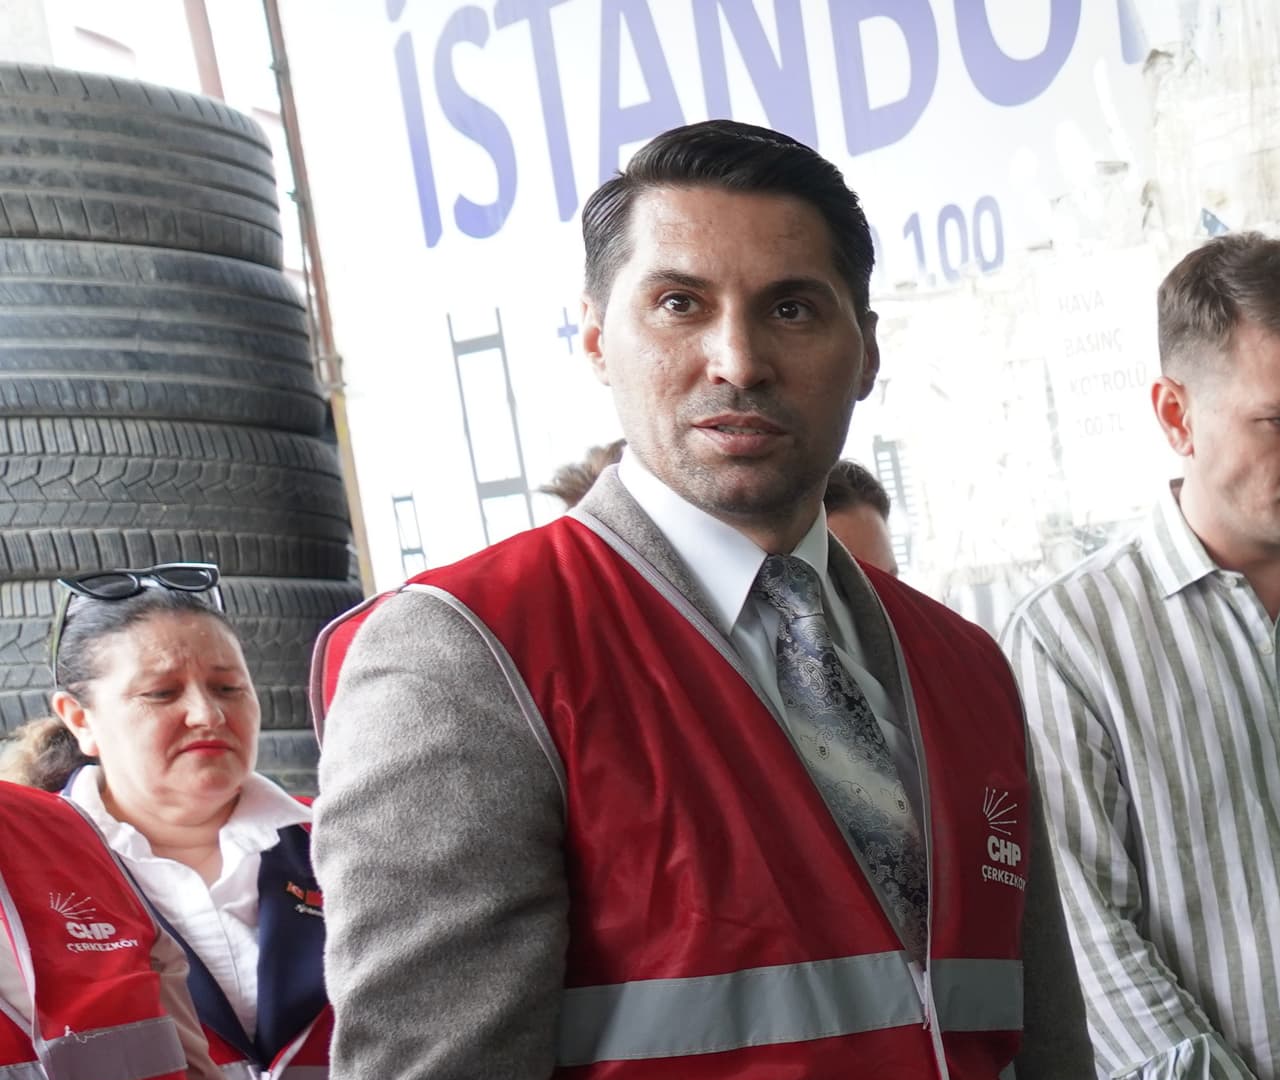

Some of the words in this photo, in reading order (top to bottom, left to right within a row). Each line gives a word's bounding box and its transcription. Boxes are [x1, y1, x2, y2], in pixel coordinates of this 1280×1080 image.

[1058, 289, 1105, 314] HAVA
[1107, 412, 1126, 432] TL
[987, 835, 1021, 866] CHP
[981, 864, 1027, 891] ÇERKEZKÖY
[66, 921, 117, 940] CHP
